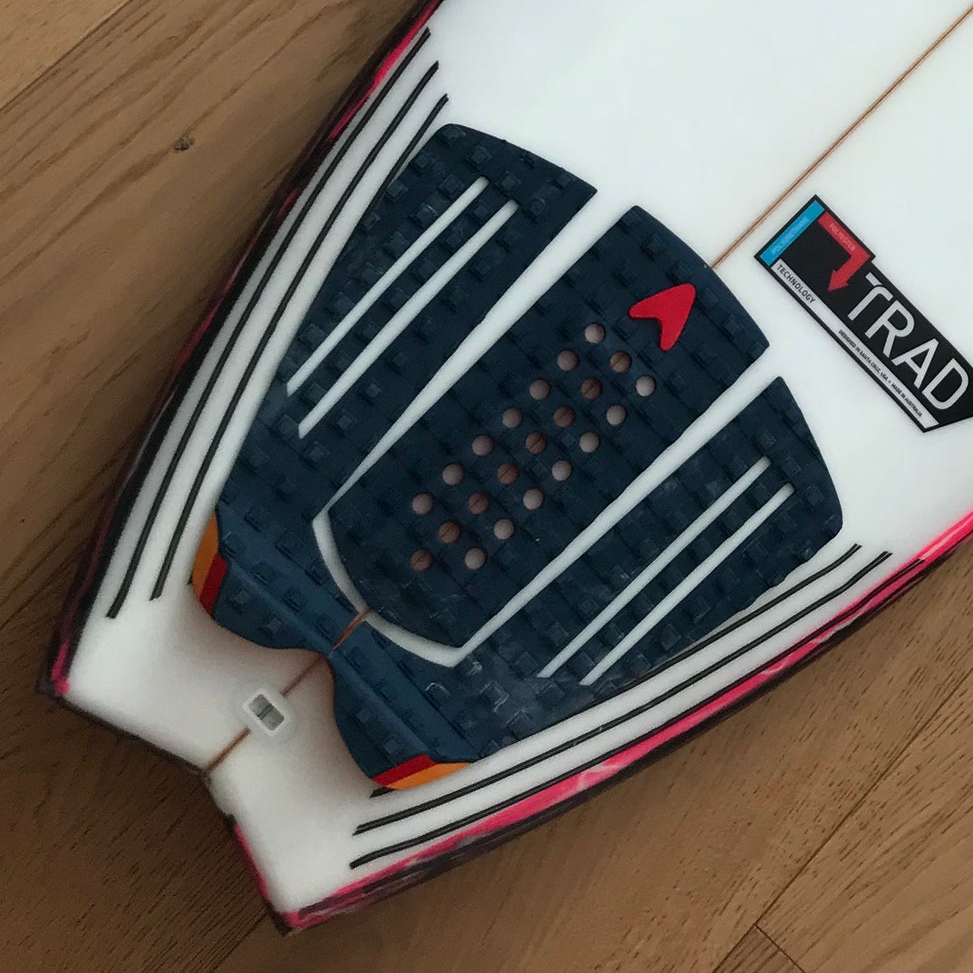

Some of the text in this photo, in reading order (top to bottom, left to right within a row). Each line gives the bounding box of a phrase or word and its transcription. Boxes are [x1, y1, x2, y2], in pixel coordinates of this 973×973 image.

[829, 223, 857, 252] POLYESTER
[776, 263, 816, 304] TECHNOLOGY
[847, 271, 969, 411] TRAD
[859, 350, 872, 364] SANTA
[880, 371, 889, 382] USA
[891, 383, 902, 395] MADE
[904, 397, 923, 418] AUSTRALIA
